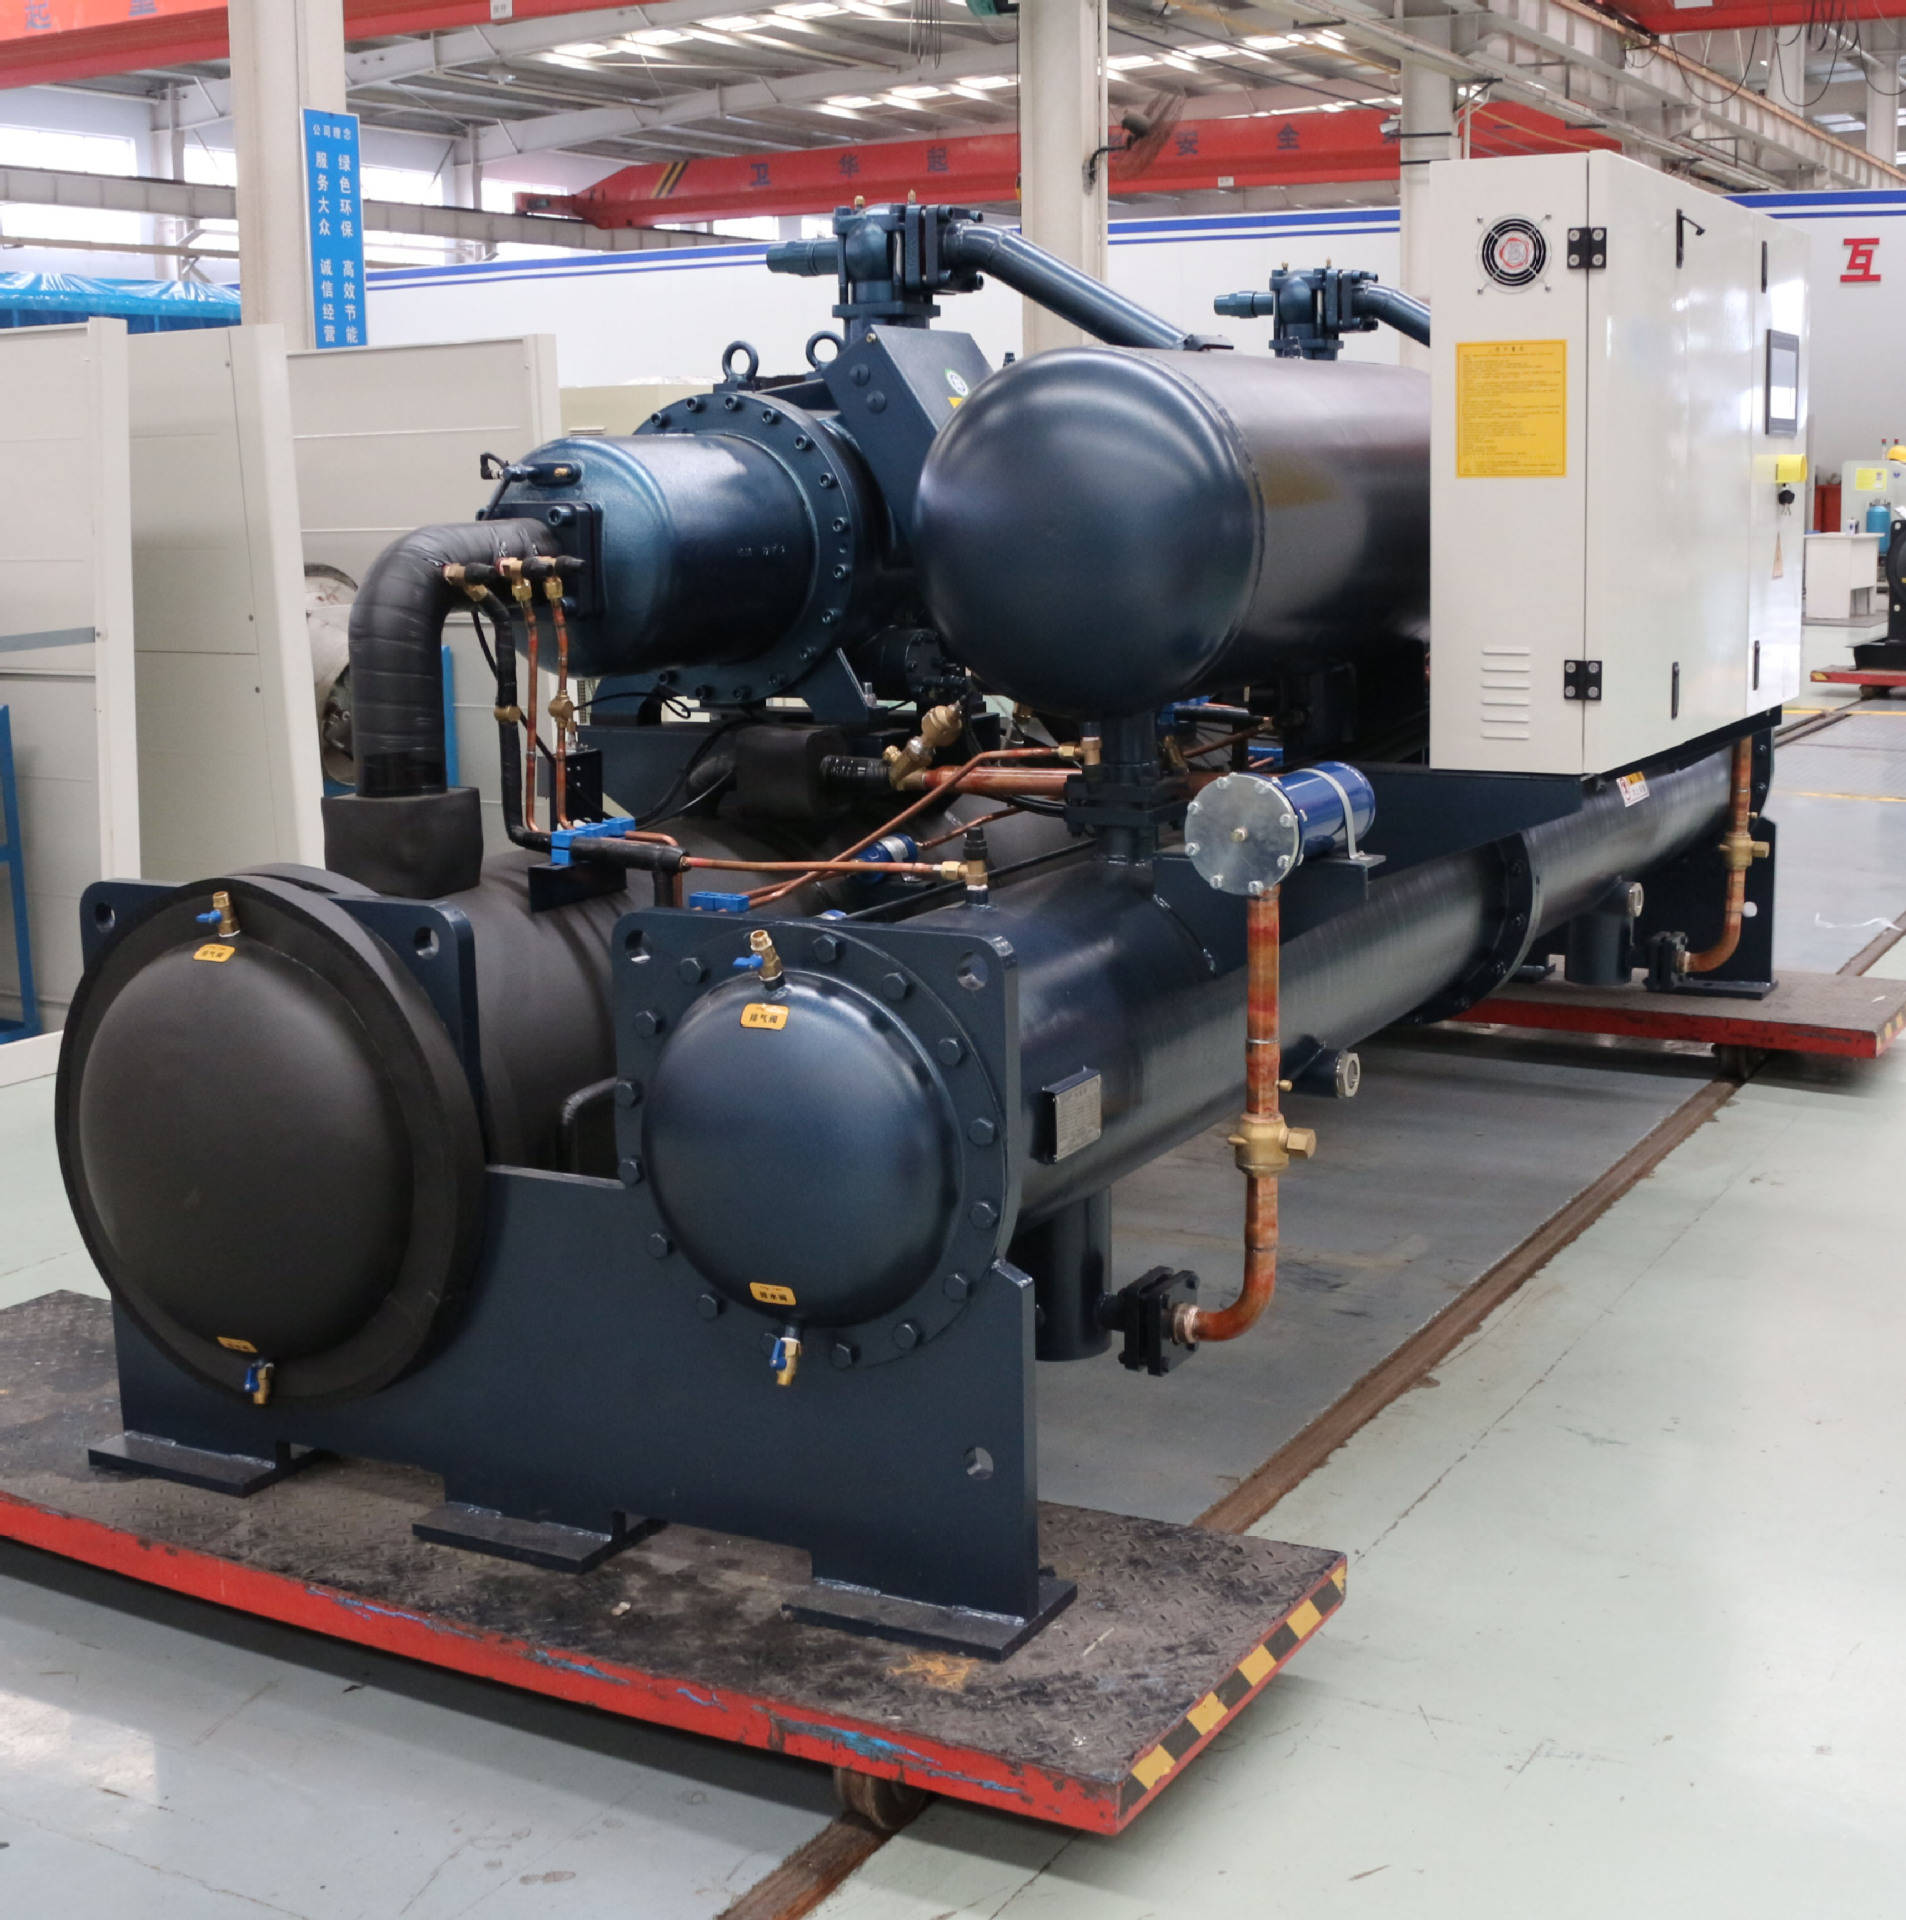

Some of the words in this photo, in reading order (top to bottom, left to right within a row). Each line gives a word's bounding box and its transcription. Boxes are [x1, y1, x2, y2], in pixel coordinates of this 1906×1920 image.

[312, 123, 352, 141] 公司理念
[315, 150, 331, 236] 服务大众
[338, 154, 354, 238] 绿色环保
[319, 258, 336, 343] 诚信经营
[342, 260, 359, 344] 高效节能
